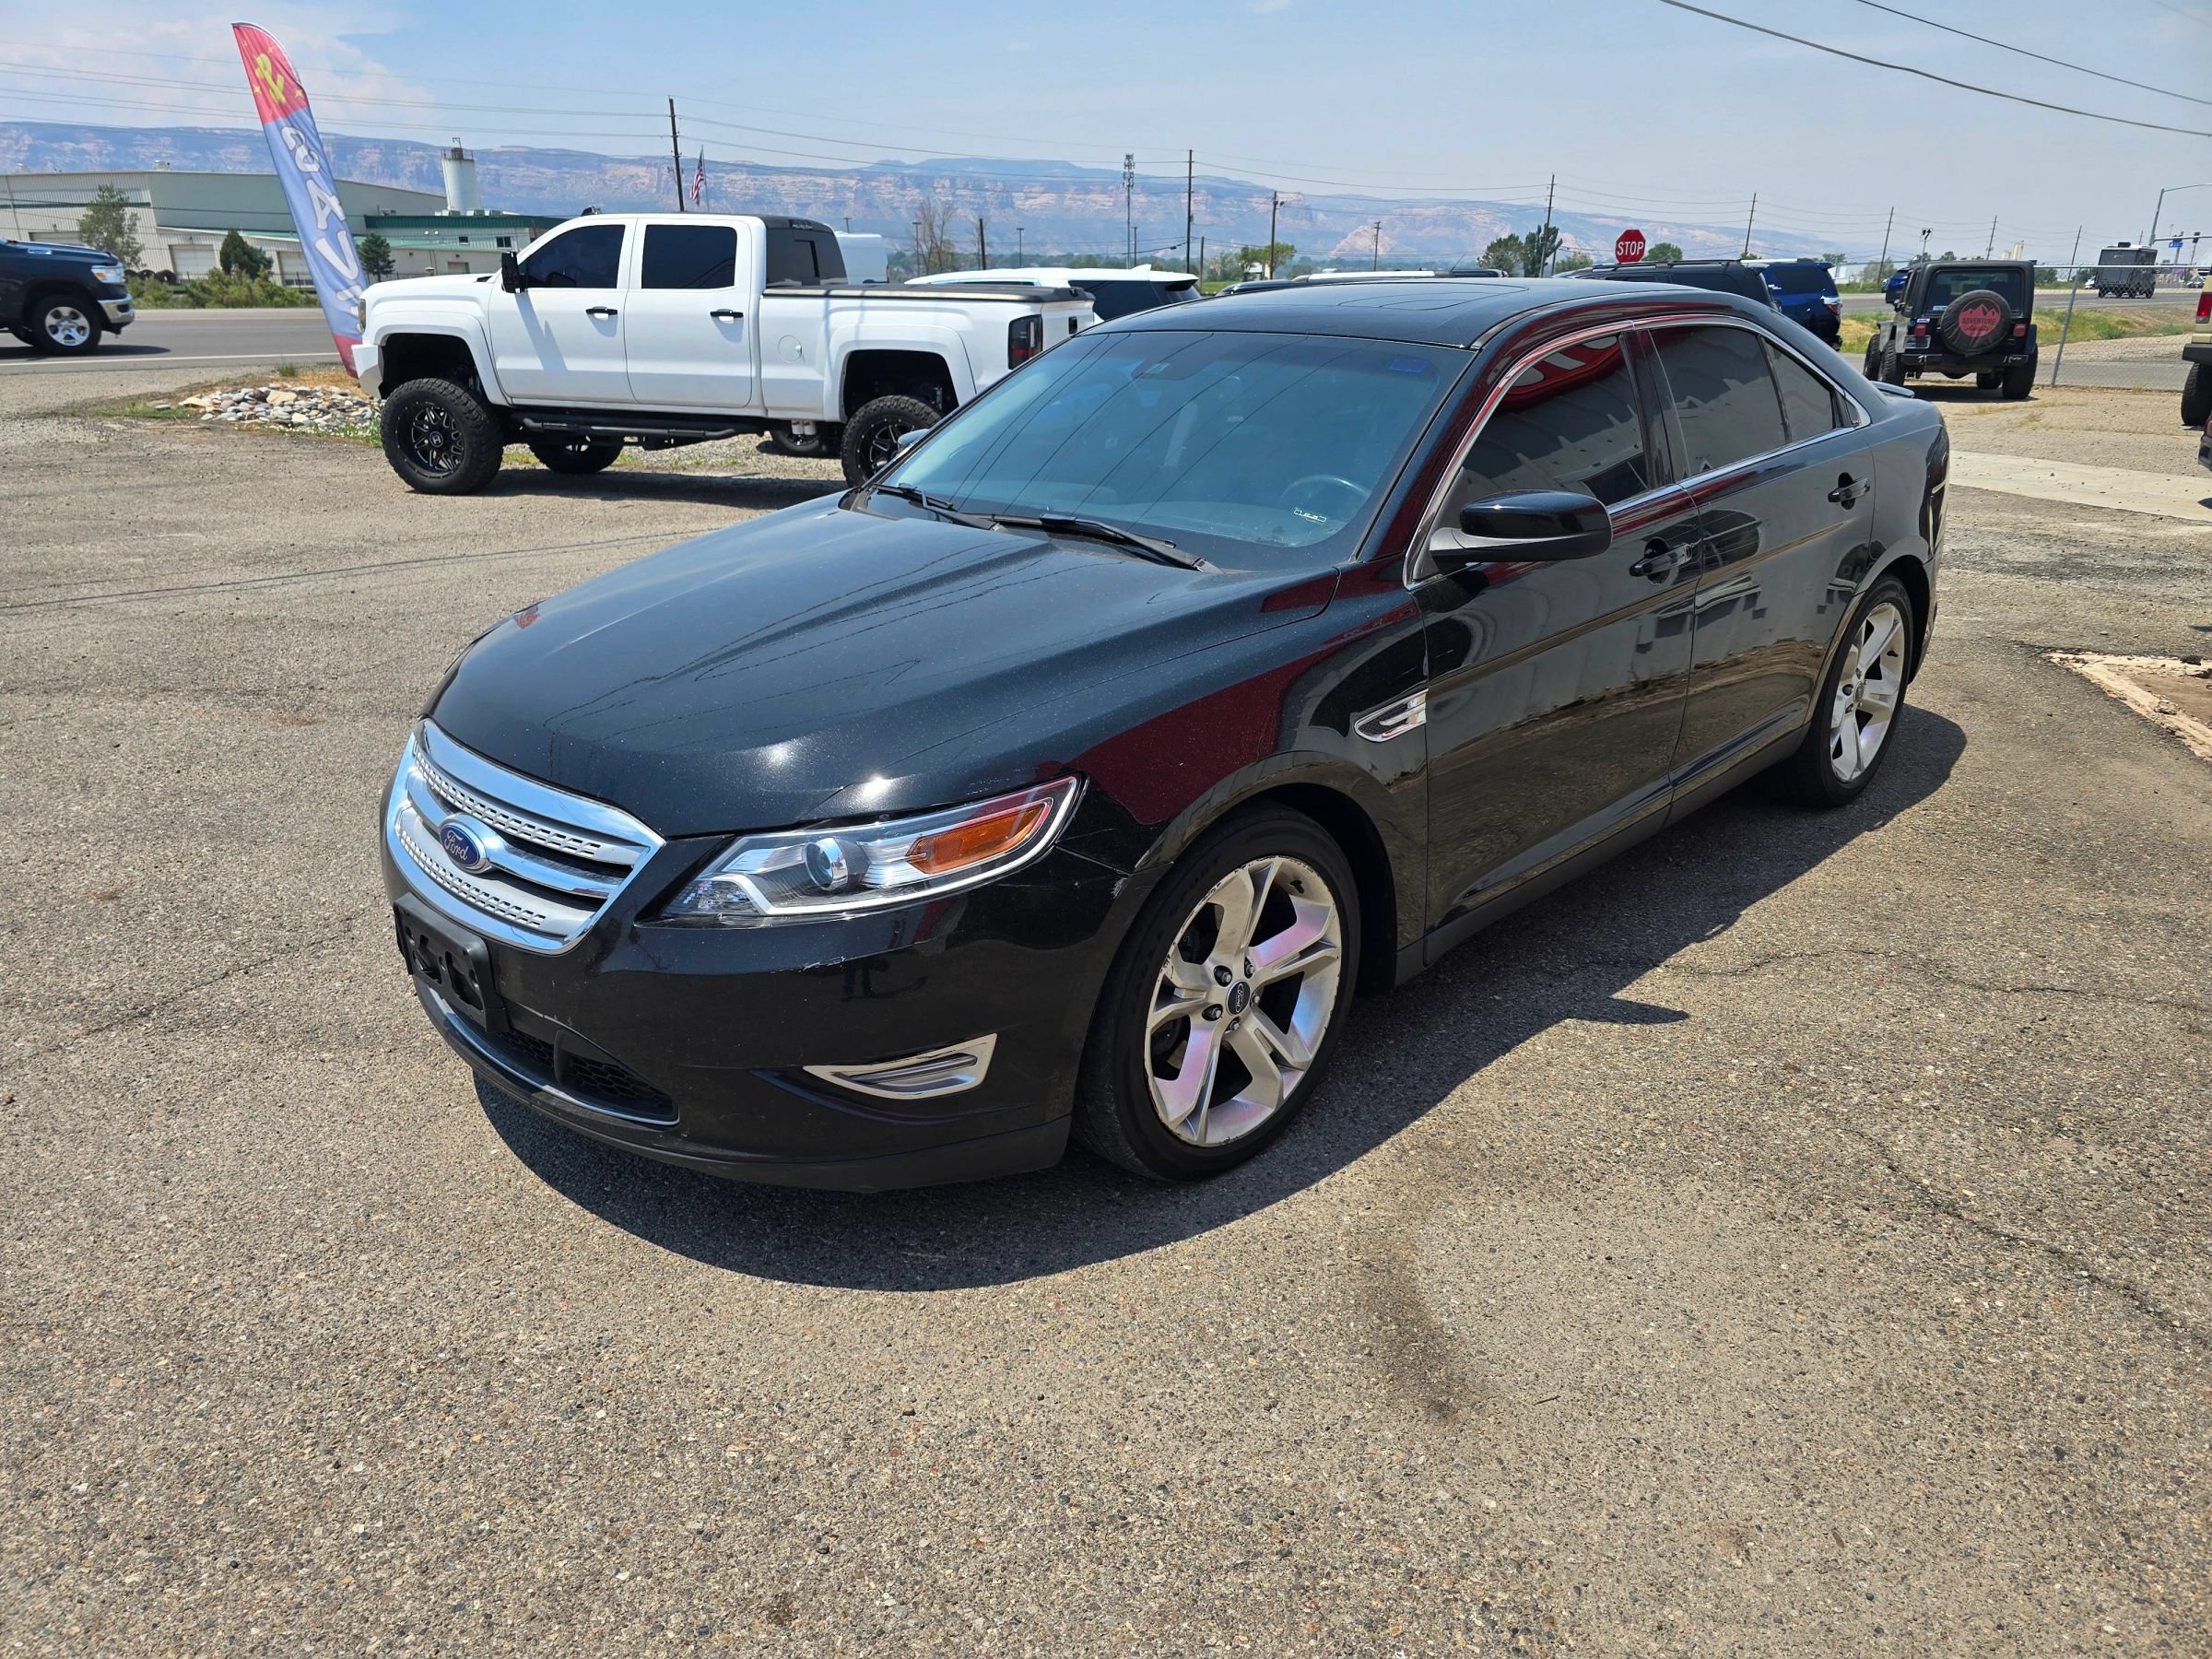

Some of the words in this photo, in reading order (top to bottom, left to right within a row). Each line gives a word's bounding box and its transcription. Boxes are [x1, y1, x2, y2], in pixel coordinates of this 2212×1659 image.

[1617, 241, 1644, 255] STOP
[1961, 317, 1998, 325] ADVENTURE
[444, 830, 468, 861] Ford
